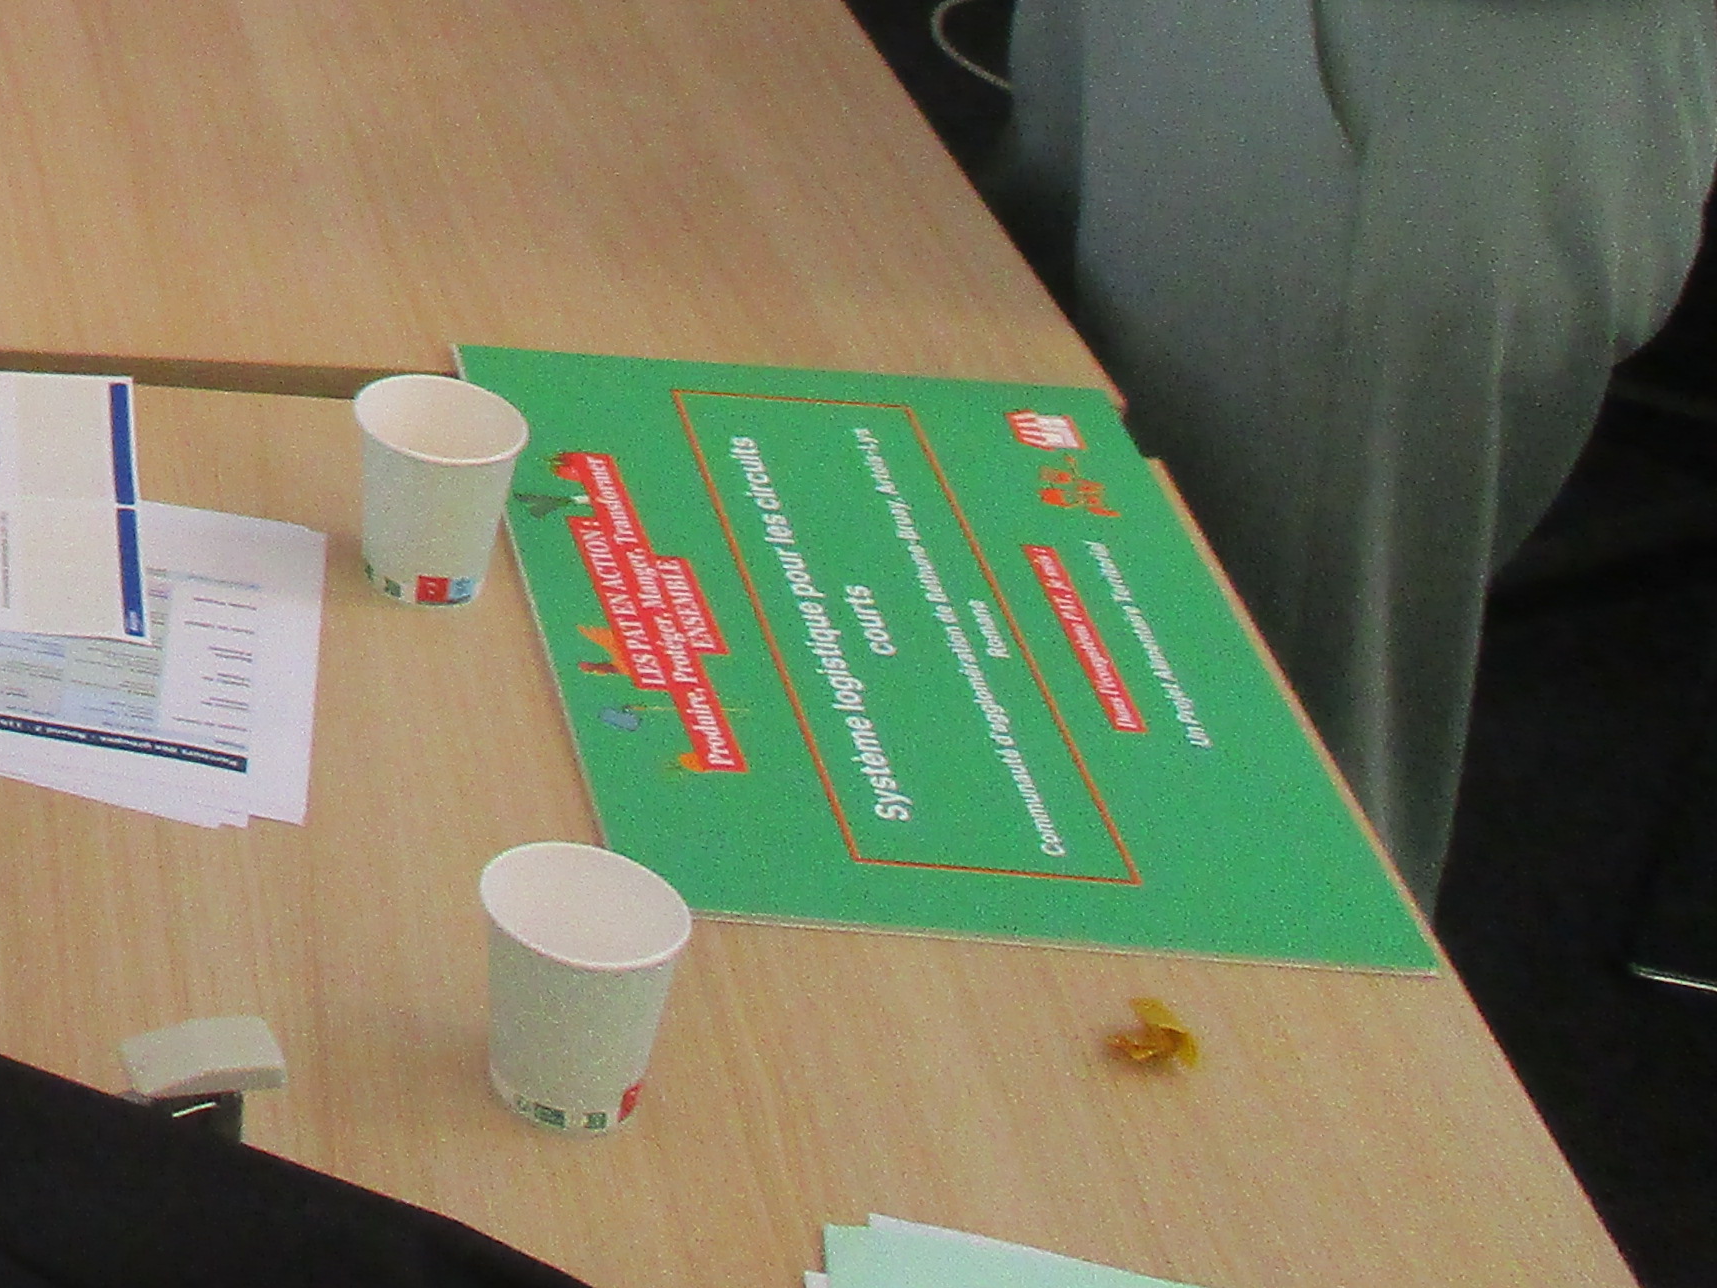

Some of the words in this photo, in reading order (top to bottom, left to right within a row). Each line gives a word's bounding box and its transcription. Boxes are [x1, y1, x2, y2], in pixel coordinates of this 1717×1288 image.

[586, 456, 636, 543] Transformer
[731, 436, 780, 510] circuits
[581, 529, 625, 590] ACTION
[762, 513, 794, 544] les
[606, 592, 636, 615] EN
[626, 548, 665, 608] Manger,
[657, 560, 714, 648] ENSEMBLE
[776, 547, 825, 598] pour
[616, 617, 652, 650] PAT
[654, 612, 697, 683] Protéger,
[845, 585, 895, 655] courts
[934, 604, 958, 624] de
[968, 599, 1009, 658] Romane
[631, 653, 666, 685] LES
[800, 601, 863, 711] logistique
[946, 625, 1014, 746] d'agglomération
[686, 687, 733, 765] Produire,
[846, 716, 911, 820] Système
[998, 748, 1065, 856] Communauté
